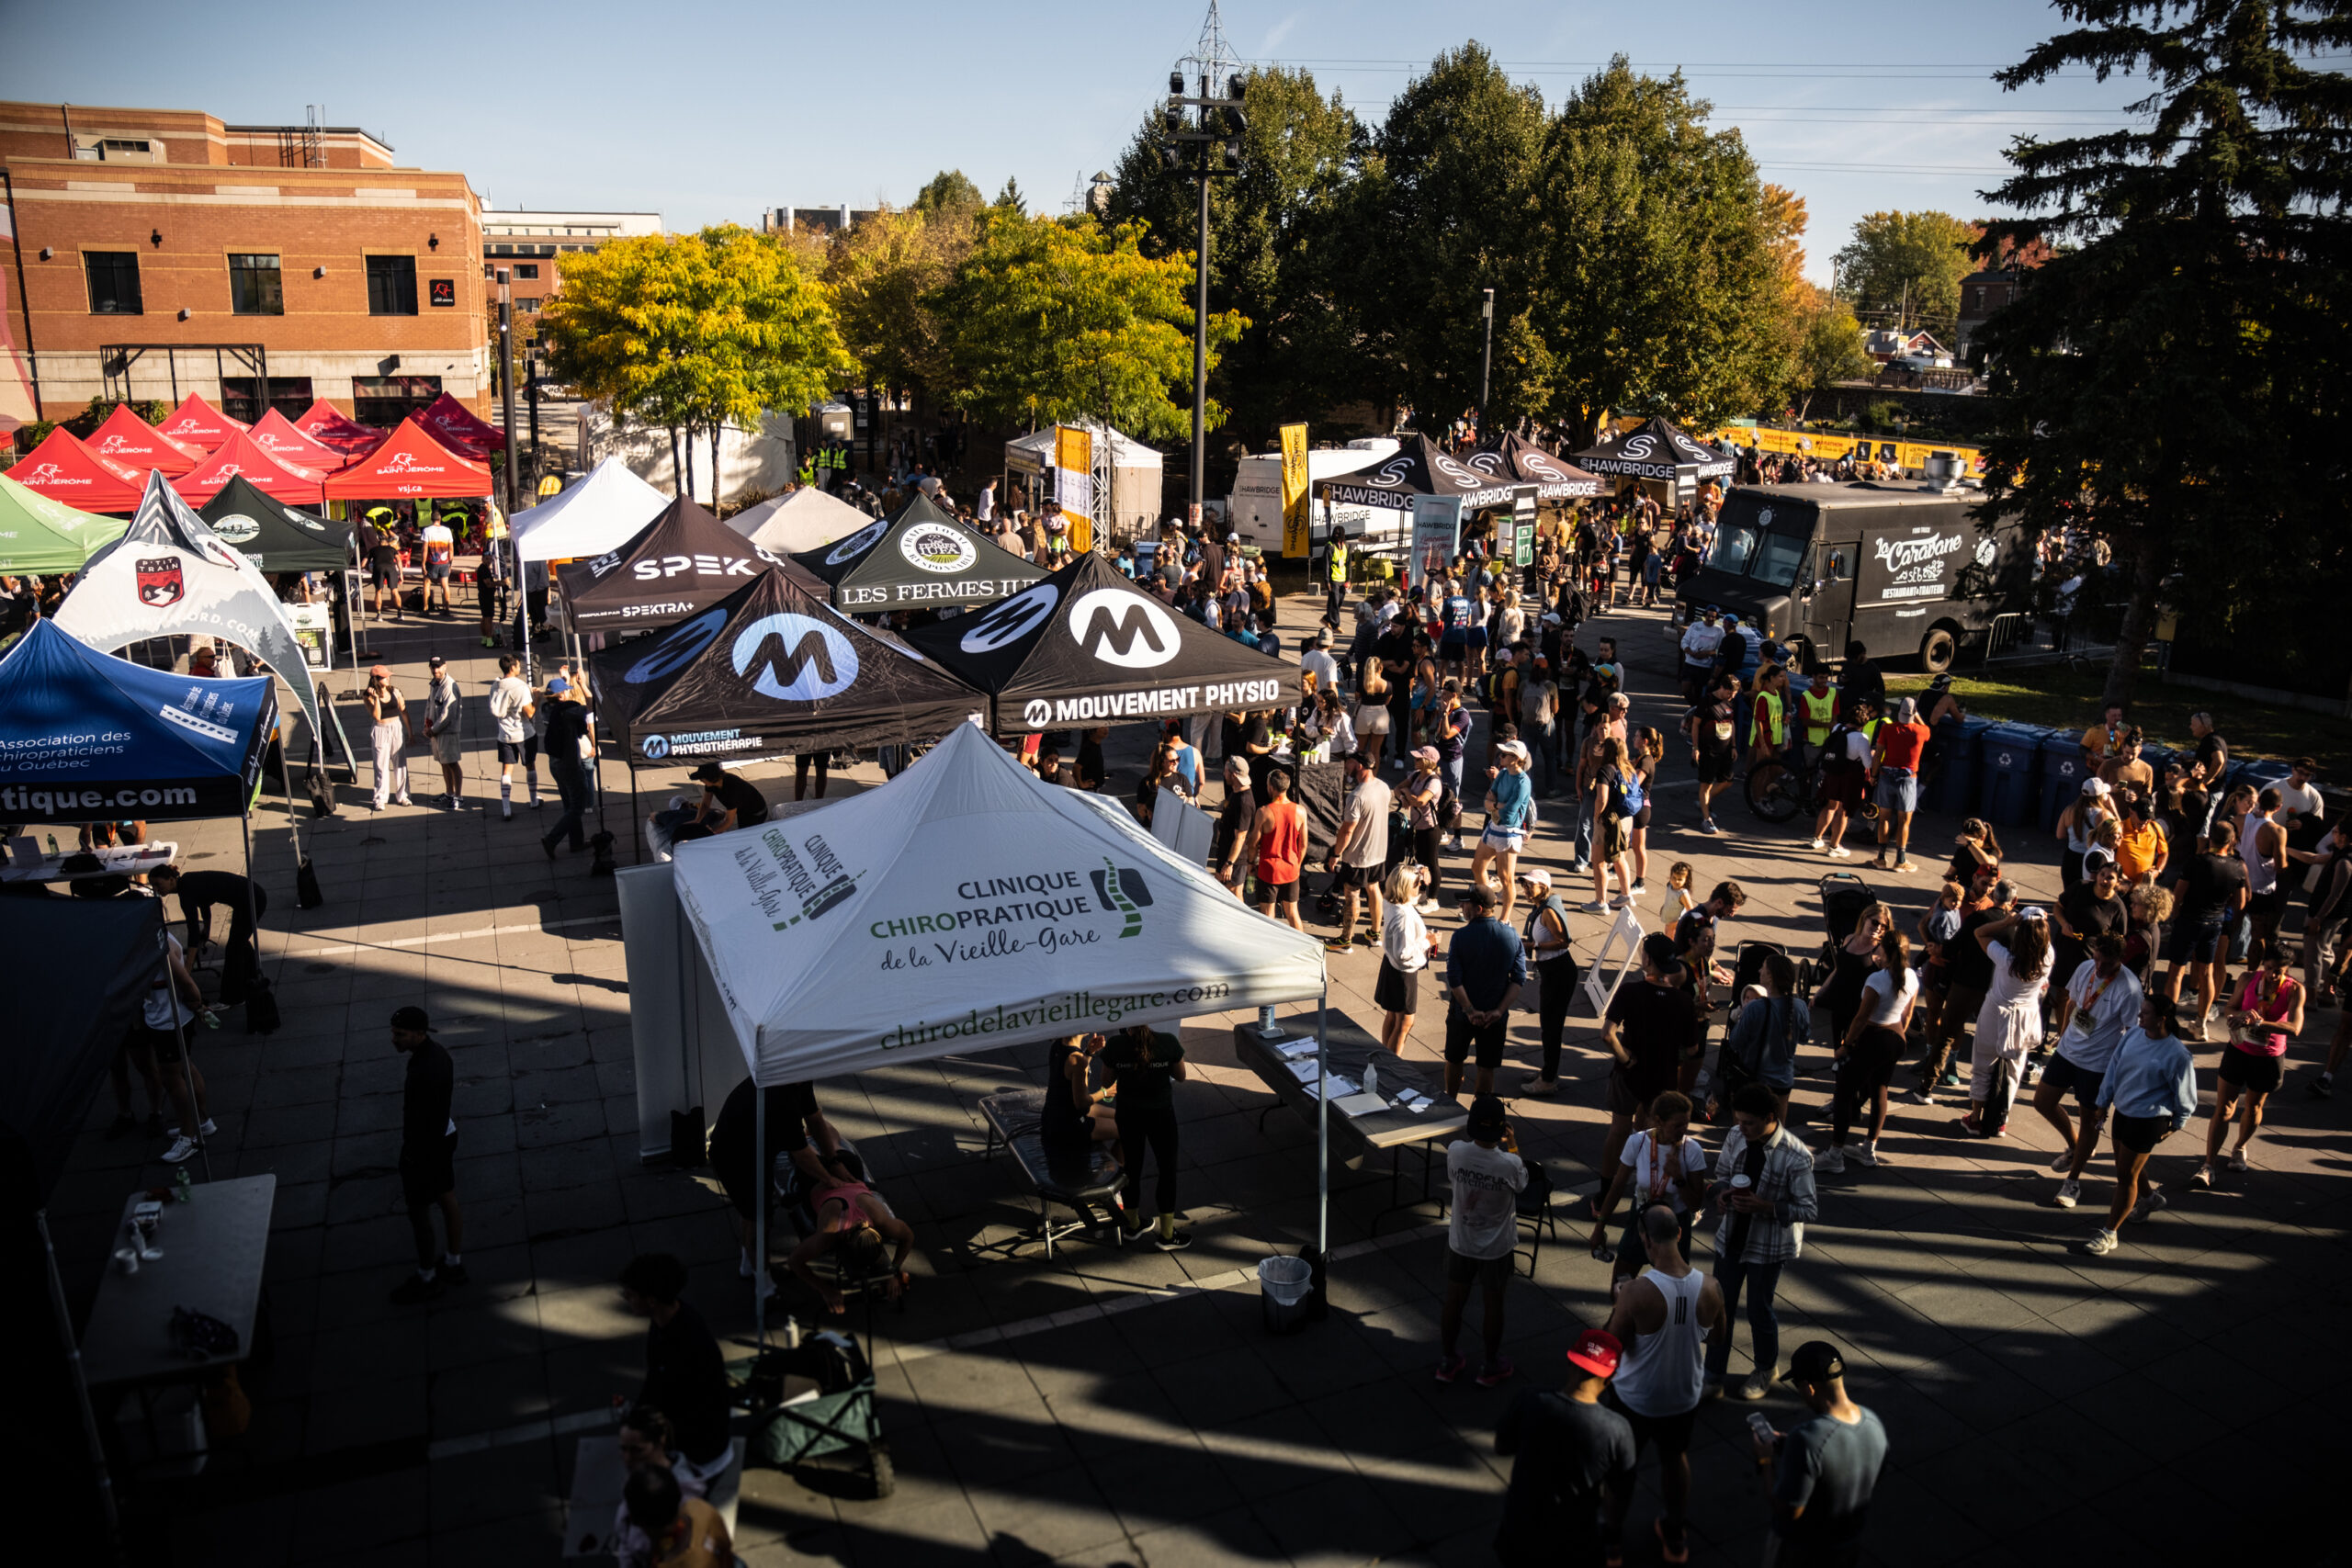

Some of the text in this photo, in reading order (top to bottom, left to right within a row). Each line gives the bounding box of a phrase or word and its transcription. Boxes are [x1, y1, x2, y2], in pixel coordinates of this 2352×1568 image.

[406, 465, 446, 473] JÉRÔME
[1289, 432, 1301, 488] SHAWBRIDGE
[1579, 457, 1675, 479] SHAWBRIDGE
[1697, 461, 1735, 479] AWBRIDGE
[47, 477, 93, 486] JÉRÔME
[200, 477, 231, 486] SAINT
[398, 484, 423, 494] vsj.ca
[1322, 483, 1415, 511] HAWBRIDG
[1314, 509, 1372, 525] HAWBRIDGE
[1416, 521, 1456, 530] HAWBRIDG
[0, 531, 18, 539] ME
[245, 553, 264, 561] THON
[1518, 543, 1532, 559] 117
[1874, 532, 1963, 573] La Caravane
[139, 563, 179, 572] TRAIN
[632, 554, 757, 581] SPEK
[842, 587, 888, 604] LES
[896, 581, 995, 602] FERMES
[621, 602, 695, 618] SPEKTRA+
[1057, 685, 1200, 722] MOUVEMENT
[1205, 679, 1280, 706] PHYSIO
[0, 731, 131, 750] Association des
[671, 728, 741, 745] MOUVEMENT
[671, 737, 763, 756] PHYSIOTHÉRAPIE
[17, 757, 91, 772] Québec
[0, 786, 198, 816] tique.com
[762, 828, 817, 899] CHIROPRATIQUE
[803, 834, 843, 880] CLINIQUE
[957, 871, 1081, 900] CLINIQUE
[869, 896, 1092, 940] CHIROPRATIQUE
[880, 926, 1101, 971] de la Vieille-Gare
[879, 980, 1231, 1052] chirodelavieillegare.com
[1452, 1168, 1503, 1192] ovement
